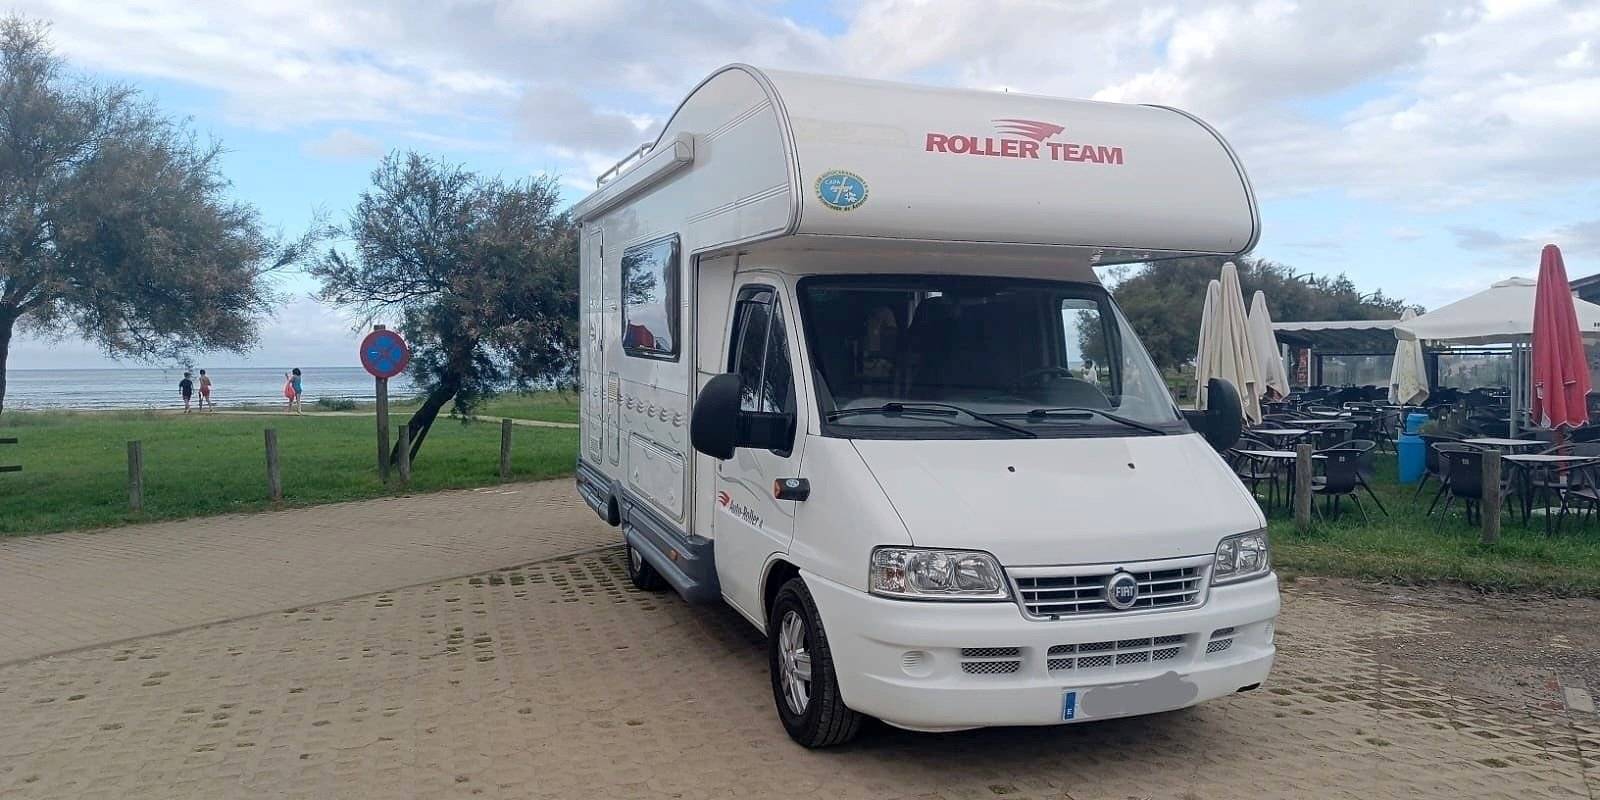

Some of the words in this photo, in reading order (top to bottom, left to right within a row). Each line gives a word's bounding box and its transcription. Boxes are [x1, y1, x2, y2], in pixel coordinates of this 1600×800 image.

[926, 132, 1039, 160] ROLLER
[1046, 141, 1124, 165] TEAM
[1116, 586, 1134, 597] FIAT
